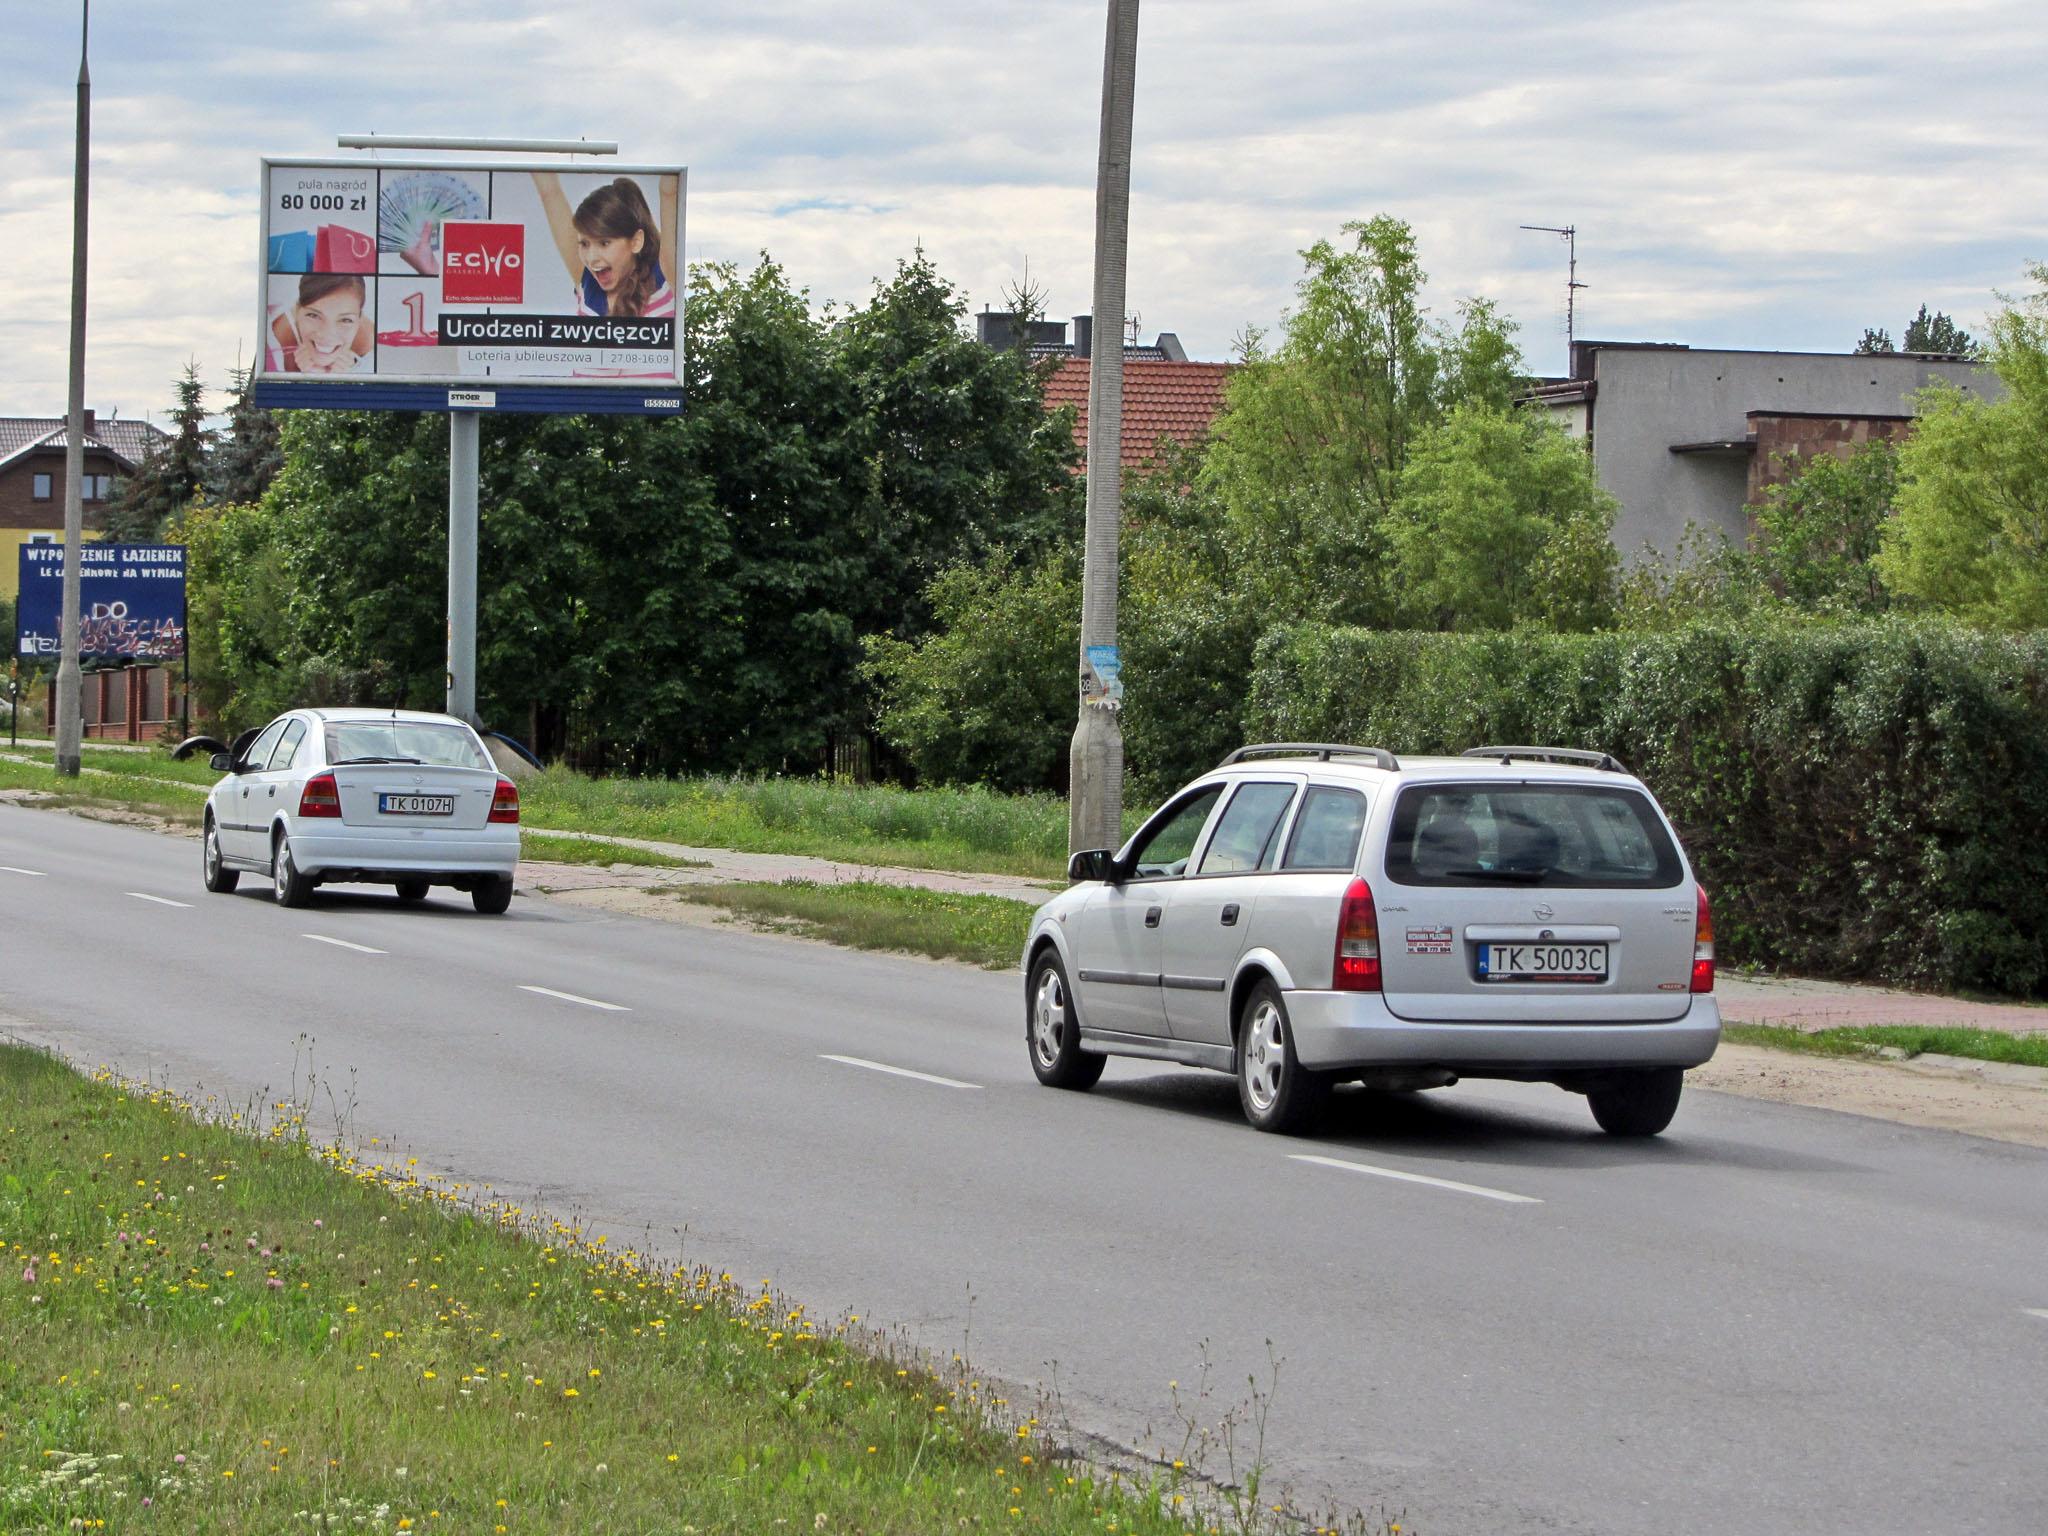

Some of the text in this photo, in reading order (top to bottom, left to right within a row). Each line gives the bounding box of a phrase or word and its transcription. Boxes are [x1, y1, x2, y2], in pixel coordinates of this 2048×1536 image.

[298, 179, 367, 192] pula nagród
[281, 195, 366, 211] 80 000 zł
[447, 244, 521, 277] ECHO
[446, 319, 669, 345] Urodzeni zwycięzcy!
[468, 351, 669, 364] Loteria jubileuszowa 27.08-16.09
[123, 549, 182, 562] ŁAZIENEK
[92, 601, 127, 620] DO
[389, 797, 451, 811] TK 0107H
[1494, 948, 1602, 971] TK 5003C
